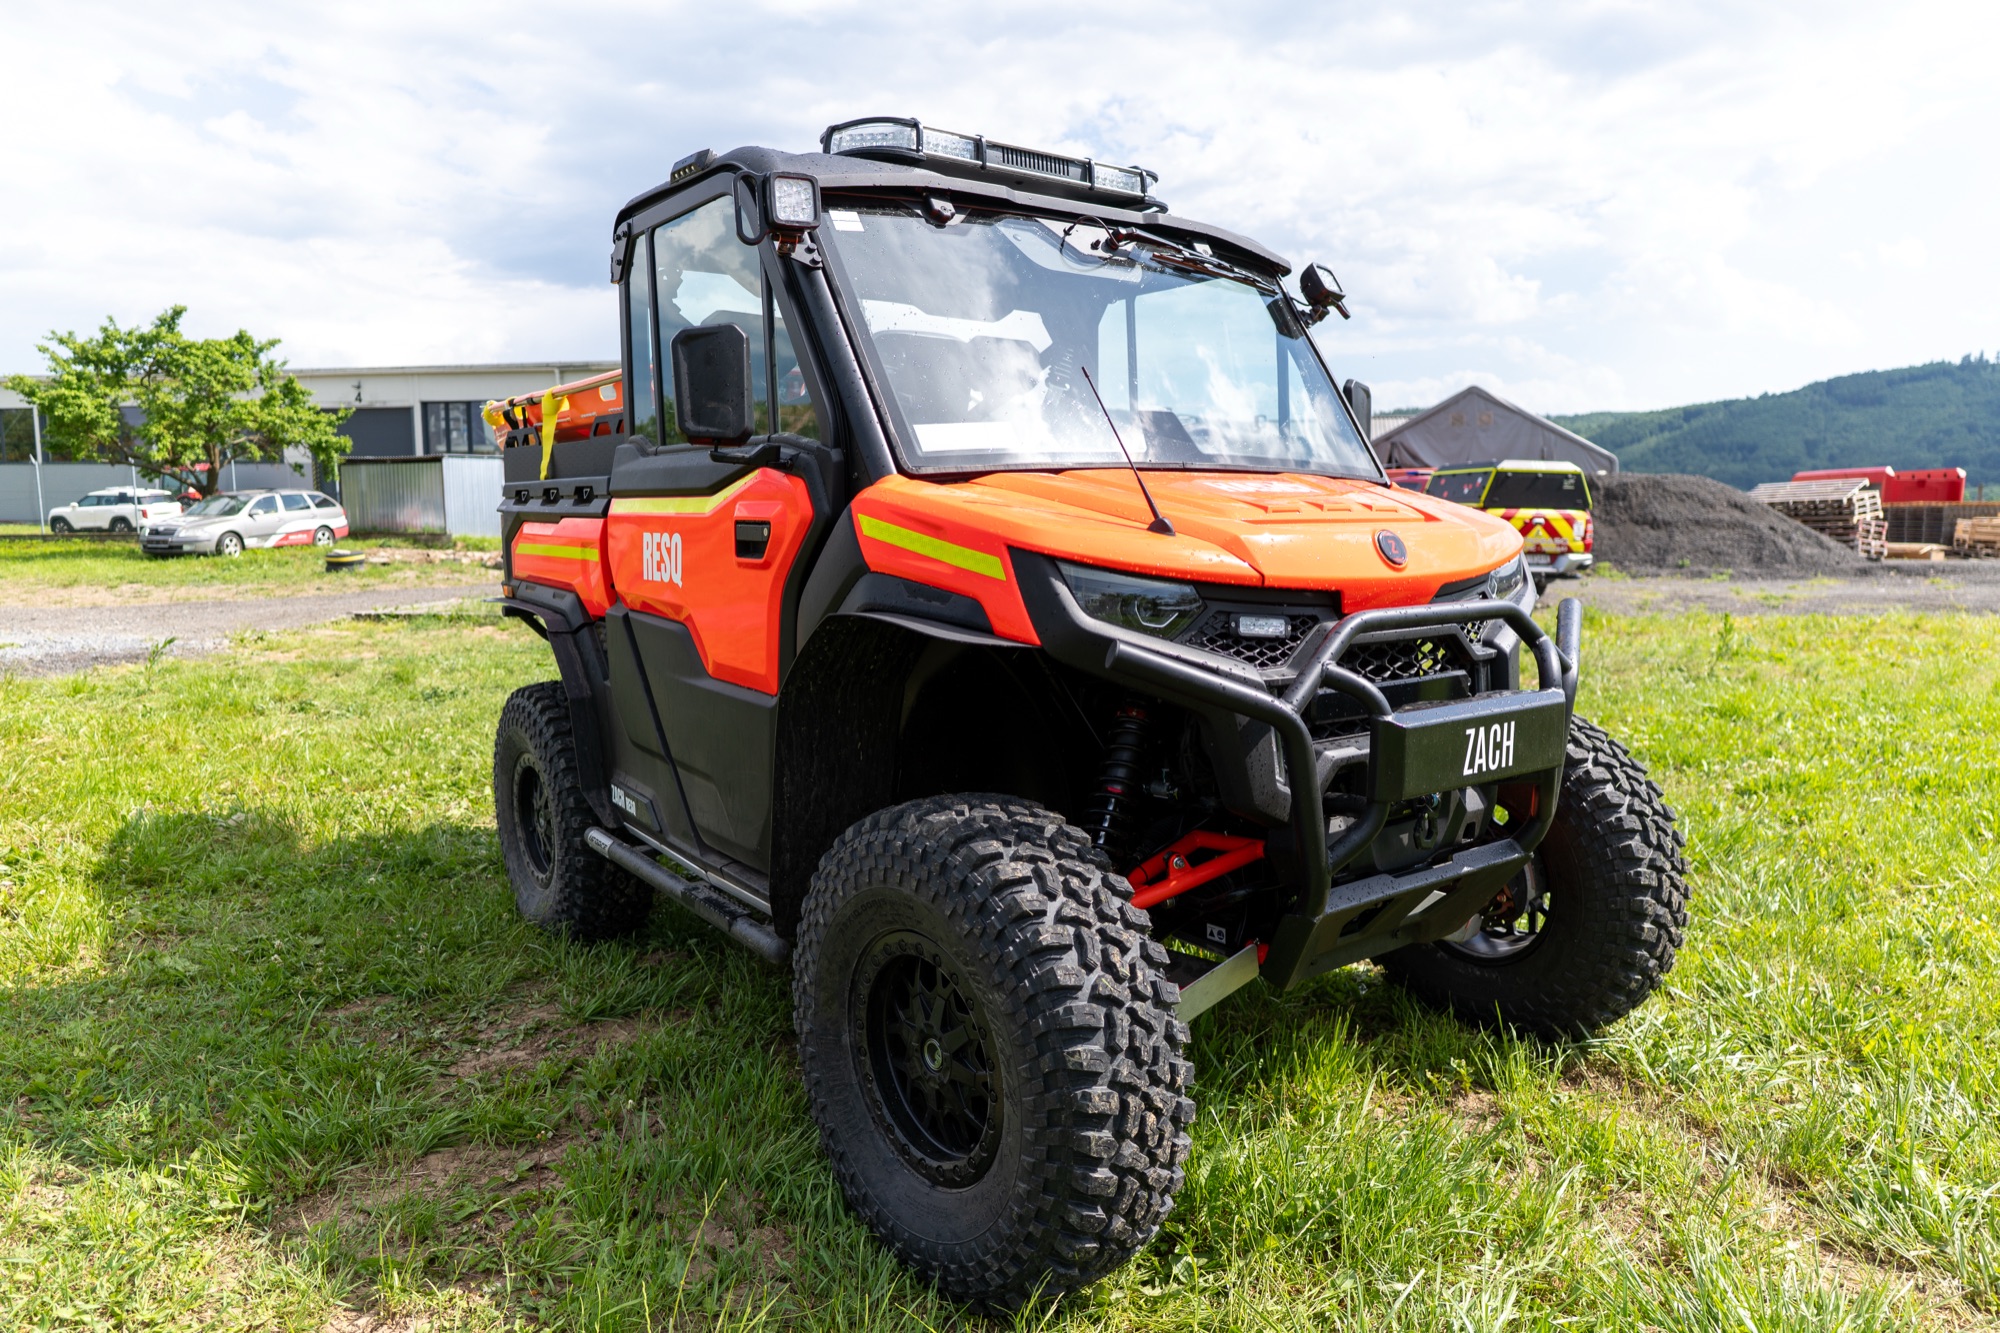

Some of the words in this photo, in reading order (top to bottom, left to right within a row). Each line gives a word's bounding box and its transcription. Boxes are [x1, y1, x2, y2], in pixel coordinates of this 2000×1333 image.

[355, 391, 363, 404] 4
[643, 532, 683, 589] RESQ
[1462, 721, 1516, 777] ZACH
